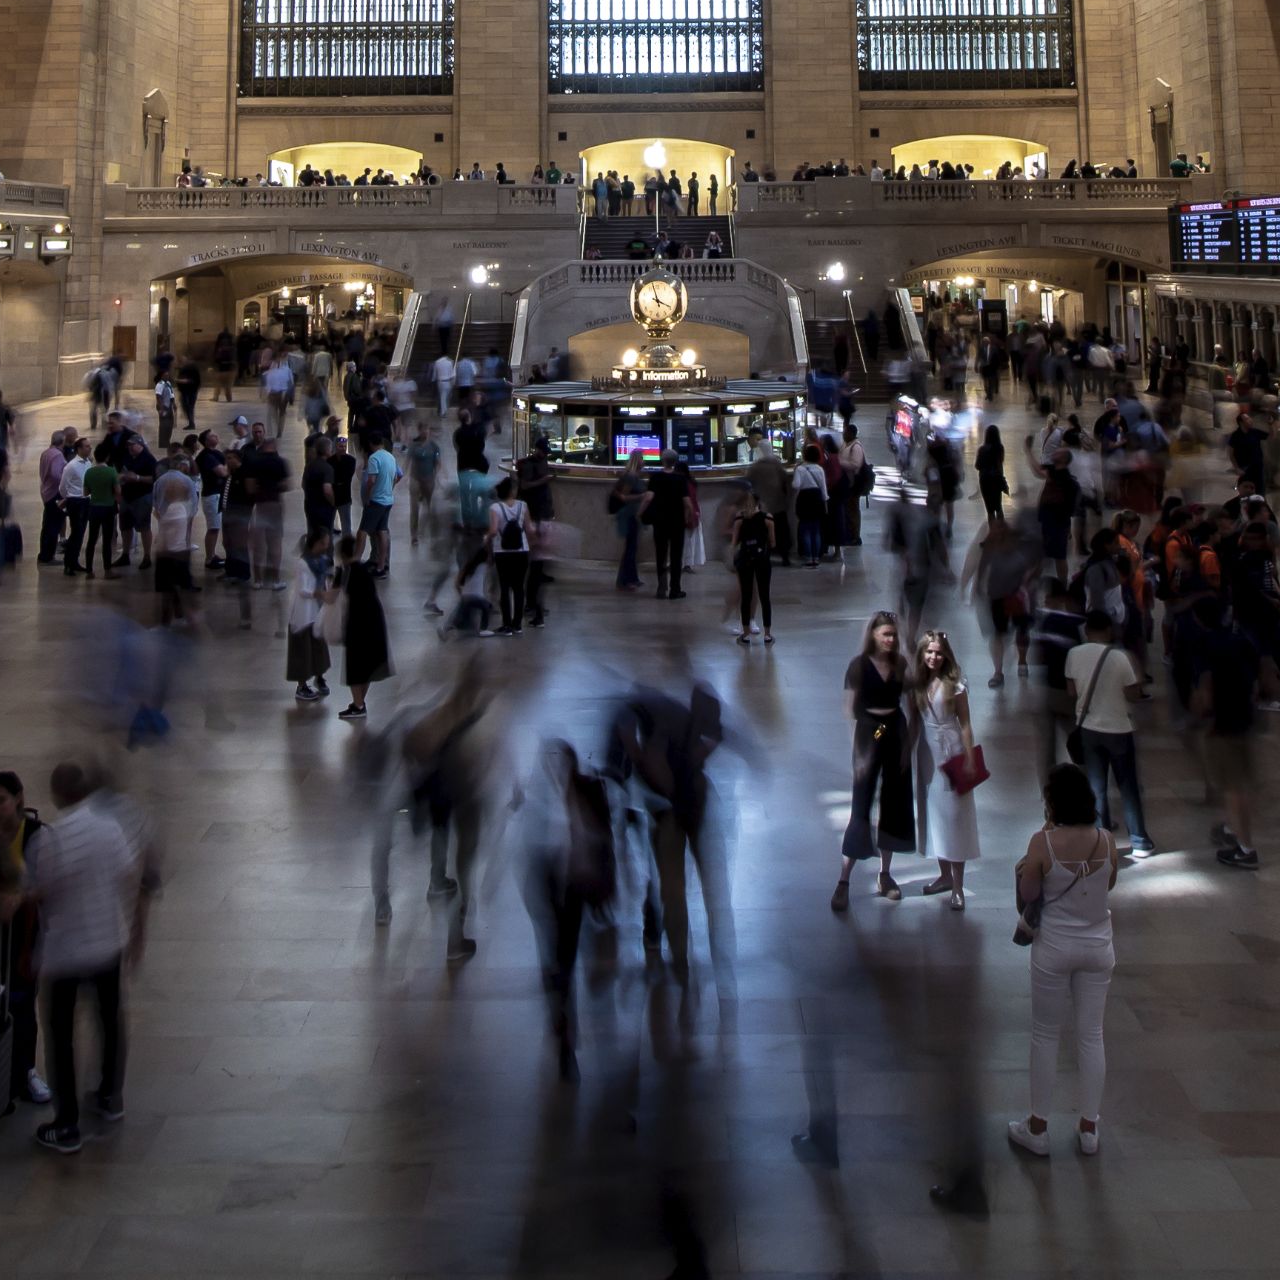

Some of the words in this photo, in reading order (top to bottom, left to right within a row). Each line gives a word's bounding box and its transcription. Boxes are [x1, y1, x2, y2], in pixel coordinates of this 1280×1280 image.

[937, 238, 995, 257] LEXINGTON
[996, 236, 1017, 245] AVE
[1052, 236, 1086, 246] TICKET
[191, 249, 229, 263] TRACKS
[301, 243, 360, 257] LEXINGTON
[361, 251, 380, 262] AVE
[309, 273, 344, 281] PASSAGE
[351, 273, 383, 281] SUBWAY
[914, 269, 944, 280] STREET
[986, 266, 1023, 275] SUBWAY
[642, 370, 689, 381] Information
